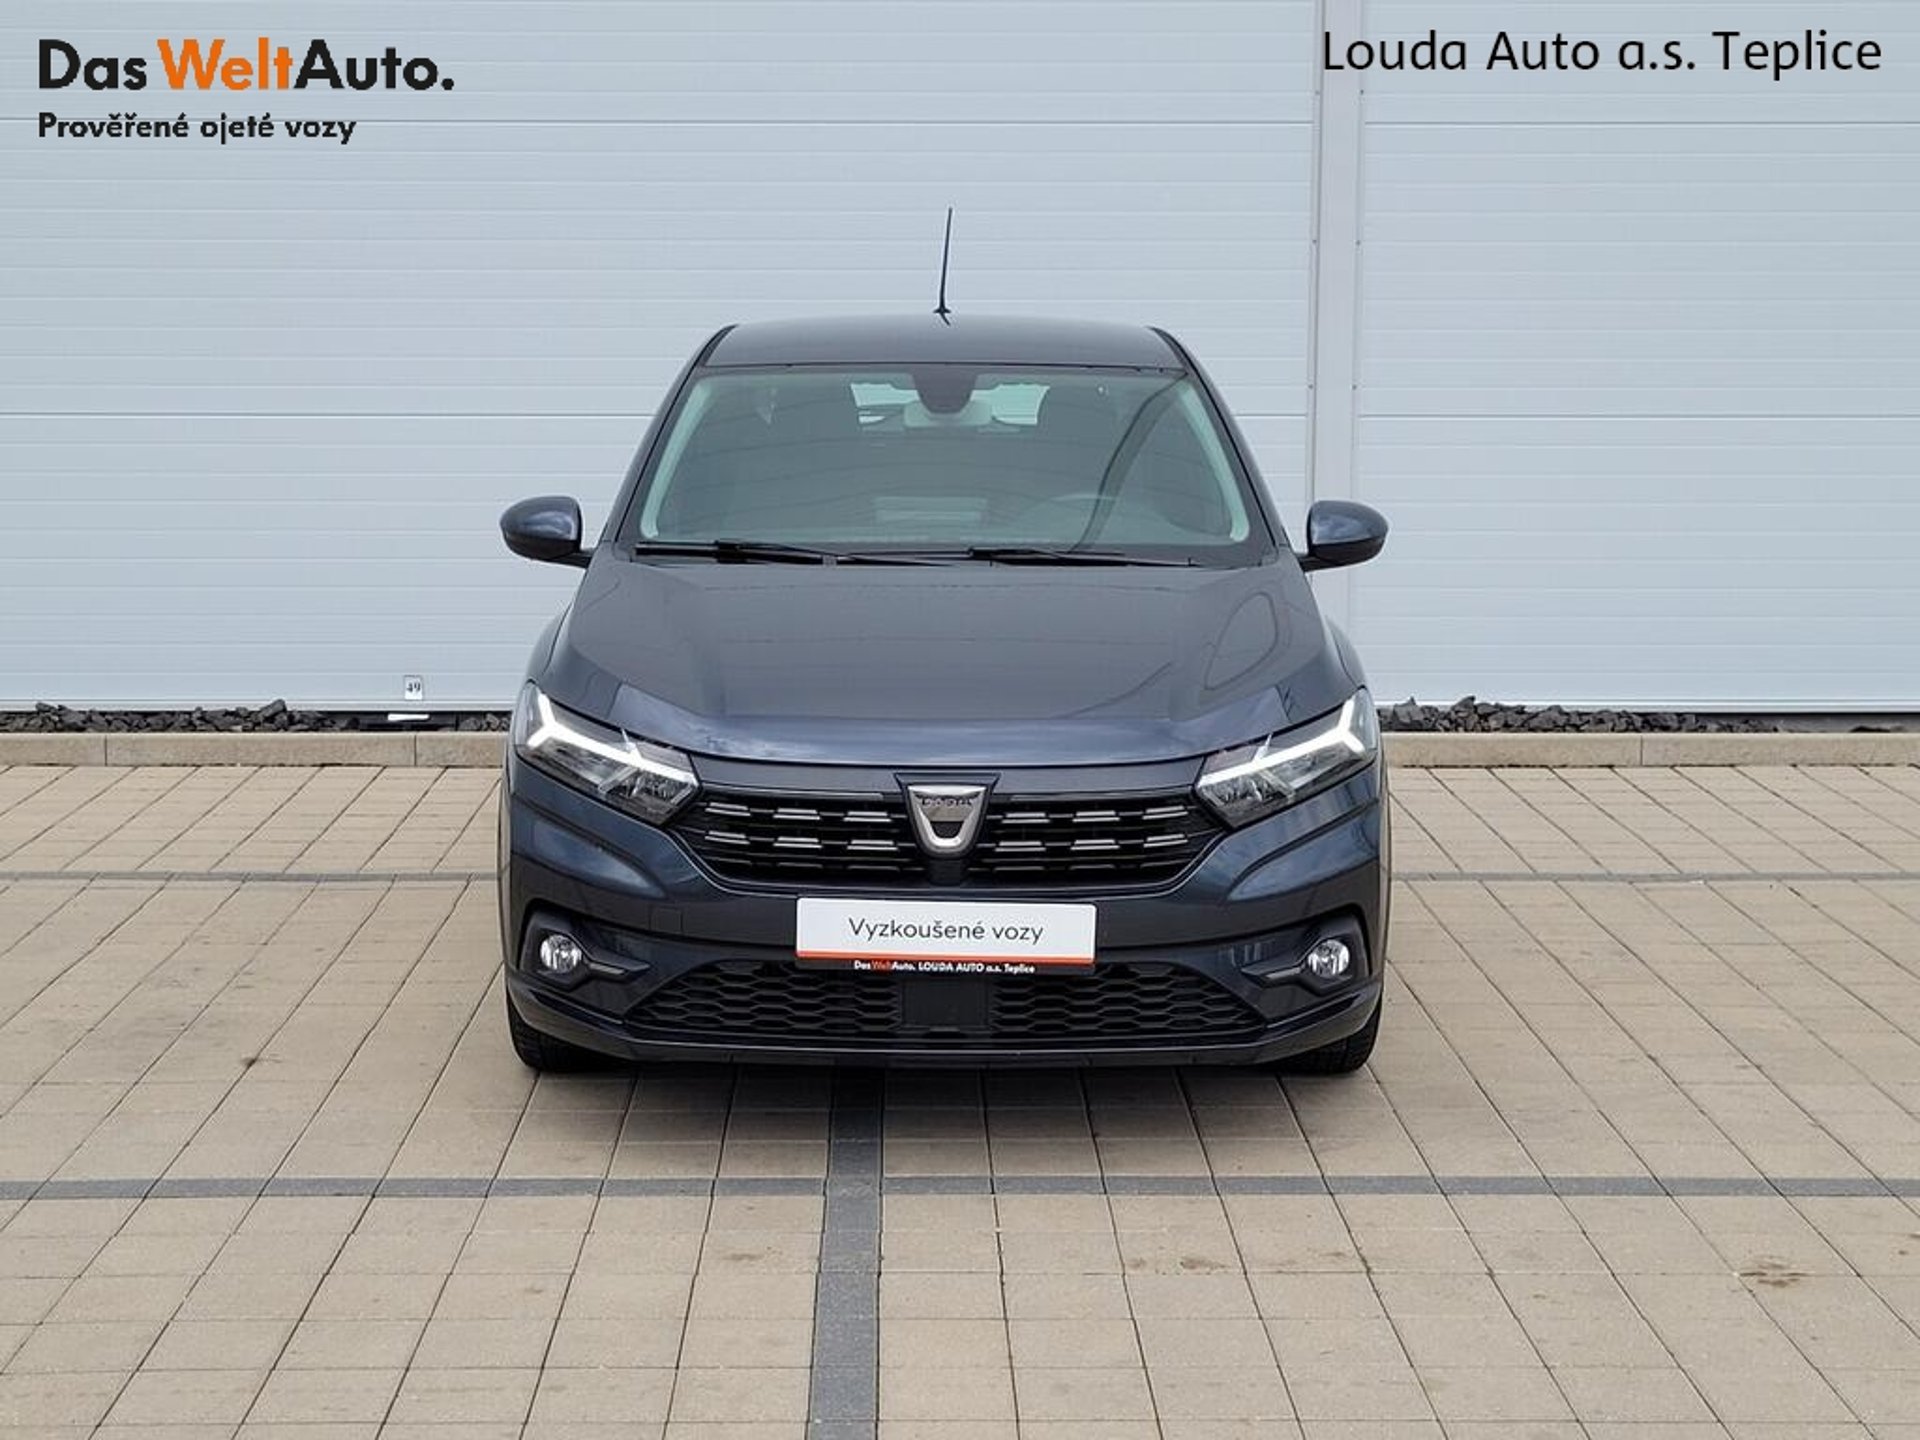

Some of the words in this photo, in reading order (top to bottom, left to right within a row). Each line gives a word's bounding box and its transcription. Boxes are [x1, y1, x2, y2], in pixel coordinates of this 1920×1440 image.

[848, 917, 986, 942] Vyzkoušené
[991, 926, 1044, 945] vozy
[918, 961, 953, 972] LOUDA
[956, 963, 984, 972] AUTO
[1004, 963, 1036, 975] Teplice
